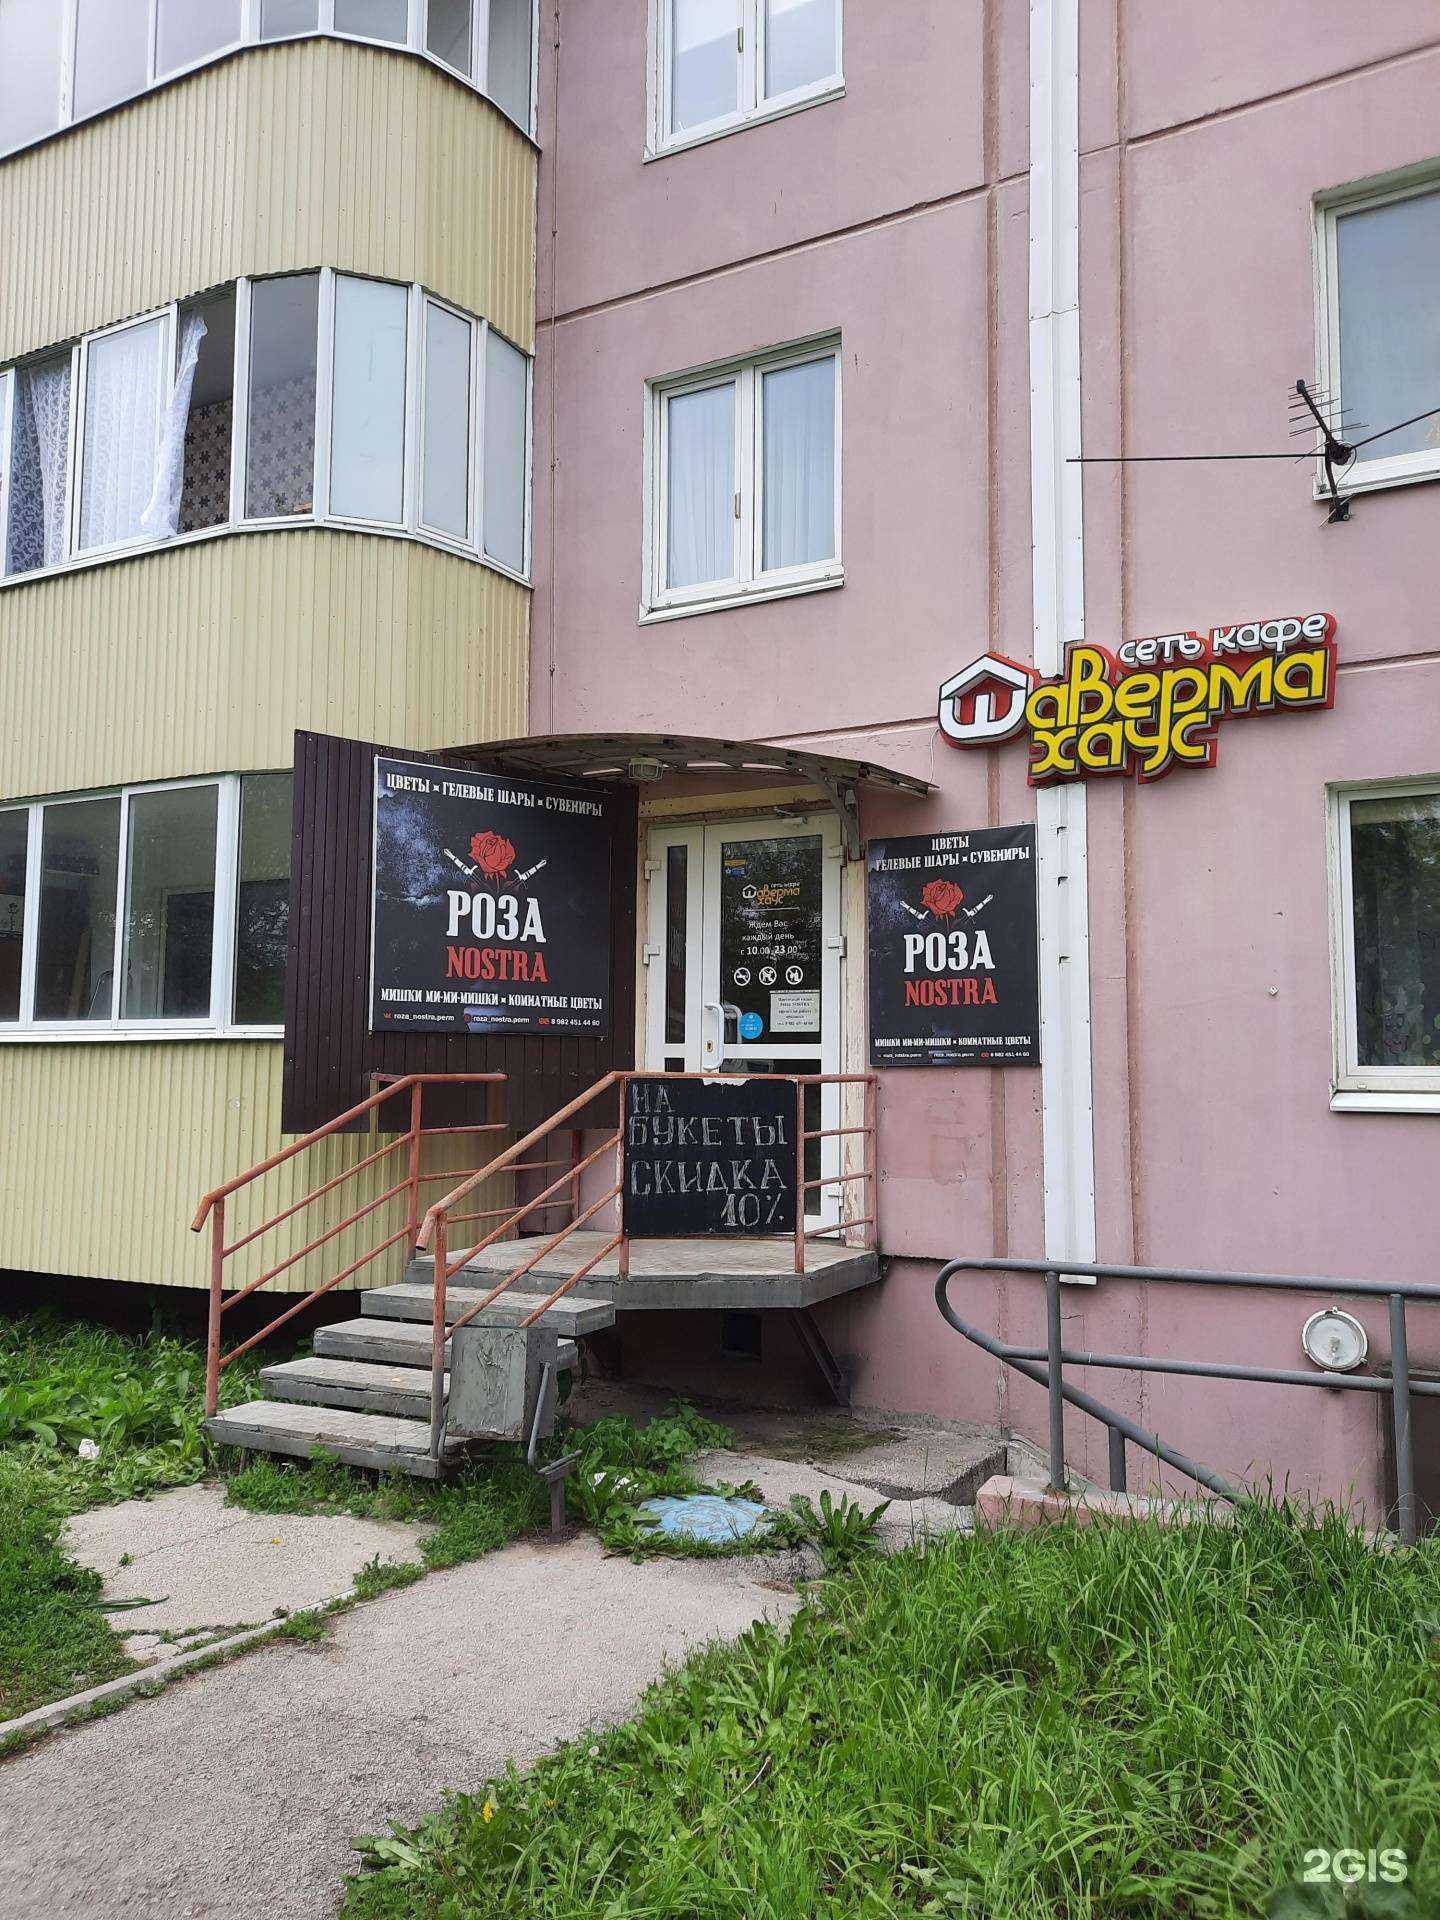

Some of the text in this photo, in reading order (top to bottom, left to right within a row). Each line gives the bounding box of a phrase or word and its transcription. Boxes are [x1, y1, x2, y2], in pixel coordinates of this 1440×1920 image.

[1119, 614, 1327, 663] сеть кафе
[1030, 712, 1209, 773] хаус
[386, 773, 602, 816] ЦВЕТЫ ГЕЛЕВЫЕ ШАРЫ СУВЕНИРЫ
[876, 846, 1030, 872] ГЕЛЕВЫЕ ШАРЫ СУВЕНИРЫ
[931, 836, 970, 852] ЦВЕТЫ
[446, 889, 547, 943] РОЗА
[742, 933, 795, 942] каждый день
[903, 929, 996, 974] РОЗА
[446, 946, 549, 983] NOSTRA
[381, 988, 603, 1010] МИШКИ МИ-МИ-МИШКИ КОМНАТНЫЕ ЦВЕТЫ
[904, 977, 999, 1007] NOSTRA
[958, 1036, 1003, 1046] КОМНАТНЫЕ
[1005, 1035, 1031, 1046] ЦВЕТЫ
[632, 1083, 675, 1114] НА
[628, 1115, 788, 1147] БУКЕТЫ
[630, 1158, 788, 1196] СКИДКА
[721, 1193, 785, 1227] 10%
